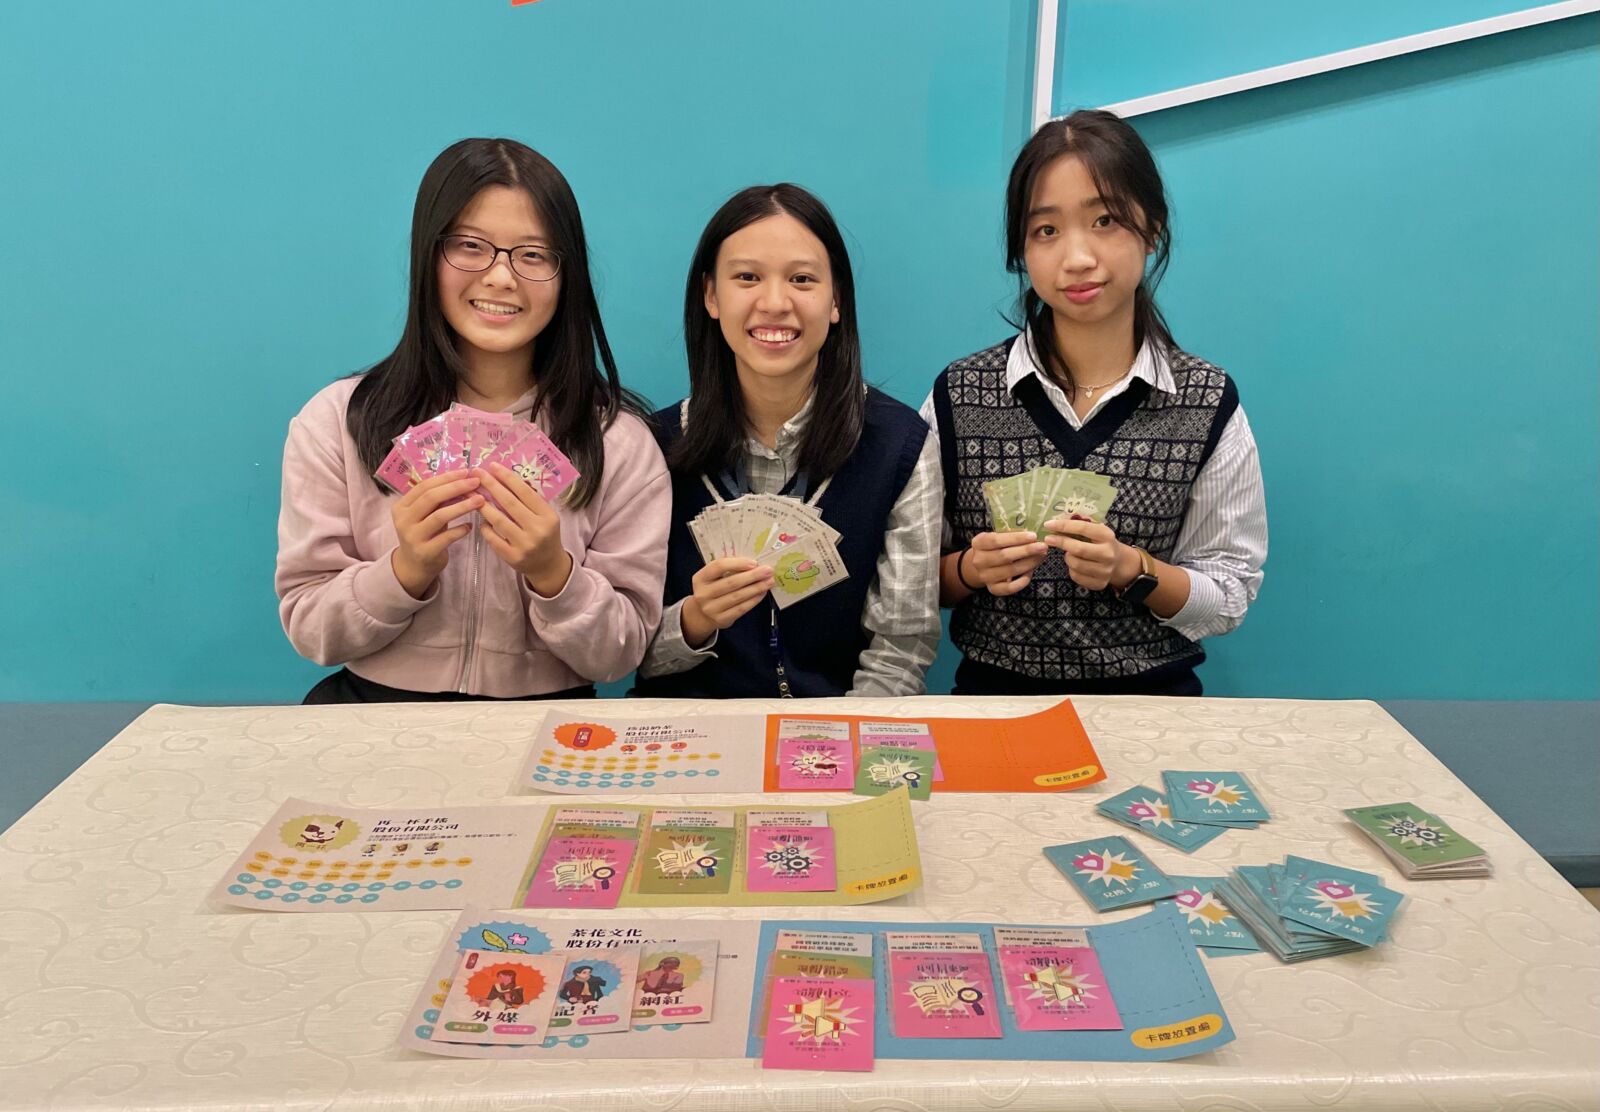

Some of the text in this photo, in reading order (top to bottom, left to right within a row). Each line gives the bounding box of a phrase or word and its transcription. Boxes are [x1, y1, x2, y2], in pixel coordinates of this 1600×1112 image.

[571, 928, 642, 937] 茶花文化
[566, 939, 676, 948] 股份有
[639, 995, 684, 1006] 網紅
[554, 1004, 600, 1016] 記者
[471, 1009, 520, 1023] 外媒
[1145, 1021, 1210, 1043] 卡牌放置處
